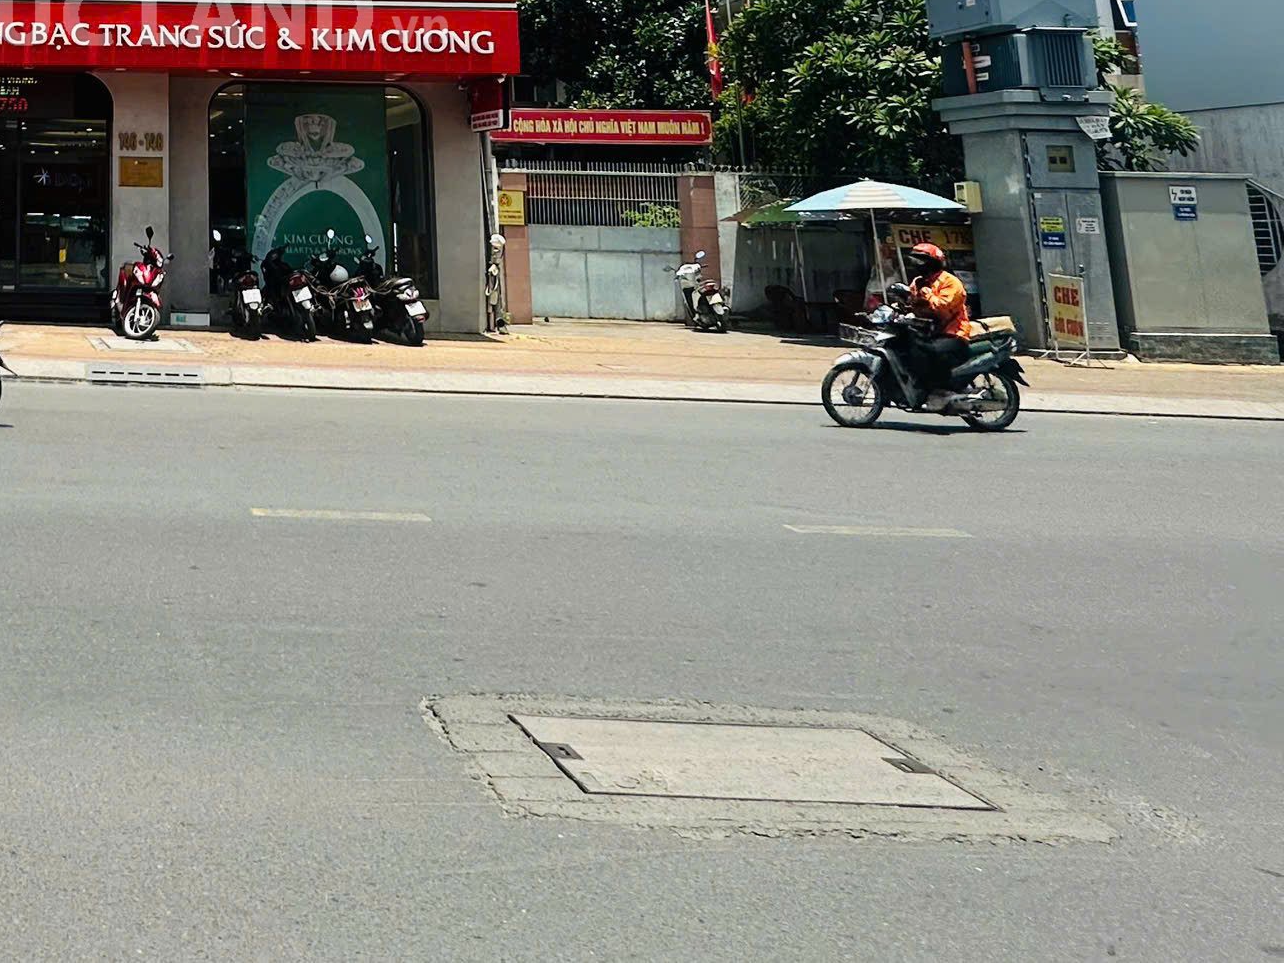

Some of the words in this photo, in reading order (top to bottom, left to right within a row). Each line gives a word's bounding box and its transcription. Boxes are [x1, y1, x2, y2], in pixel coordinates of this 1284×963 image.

[31, 22, 90, 51] BẠC
[98, 24, 202, 48] TRANG
[207, 19, 266, 50] SỨC
[277, 27, 303, 51] &
[311, 28, 377, 52] KIM
[381, 27, 495, 54] CƯƠNG
[513, 117, 535, 135] CỘNG
[535, 117, 551, 133] HÒA
[552, 117, 564, 133] XÃ
[579, 117, 595, 133] CHỦ
[283, 234, 307, 244] KIM
